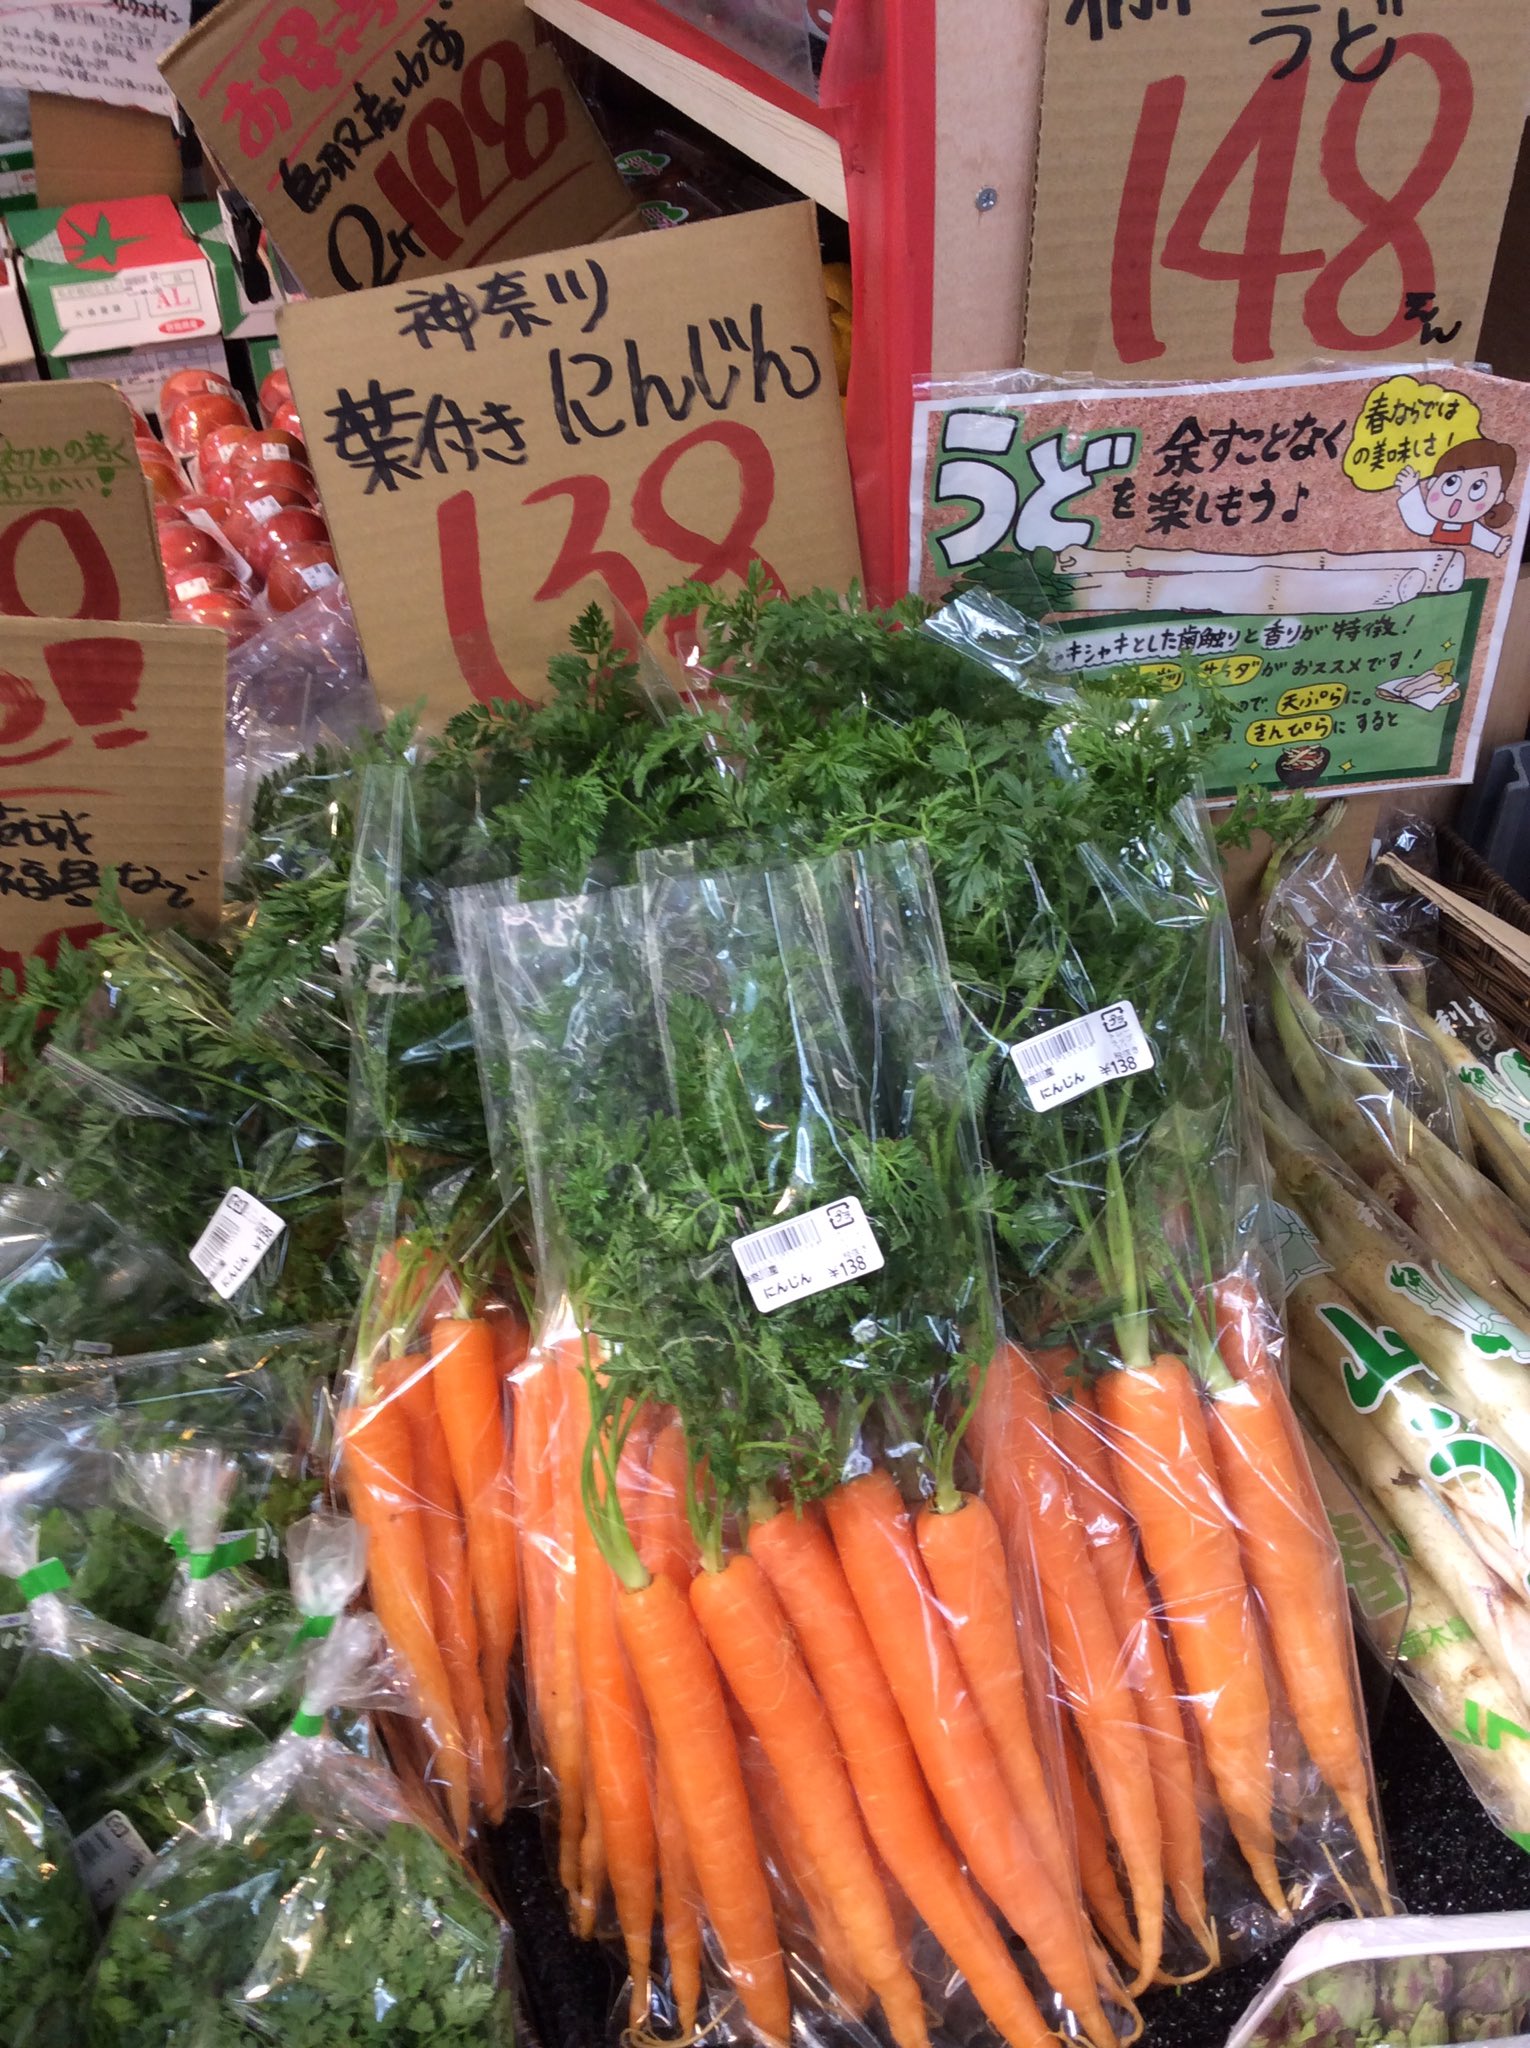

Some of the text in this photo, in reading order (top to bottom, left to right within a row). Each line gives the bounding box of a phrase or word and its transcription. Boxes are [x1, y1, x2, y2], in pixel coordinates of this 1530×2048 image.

[1249, 0, 1405, 83] うど
[374, 39, 567, 261] 128
[1110, 32, 1474, 361] 148
[323, 302, 822, 495] 葉付き にんじん
[1153, 412, 1347, 477] 余すことなく
[1365, 392, 1460, 435] 春ならでは
[933, 408, 1136, 569] うど
[436, 419, 790, 710] 138
[1040, 1056, 1138, 1100] にんじん ¥138
[763, 1255, 867, 1299] にんじん ¥138
